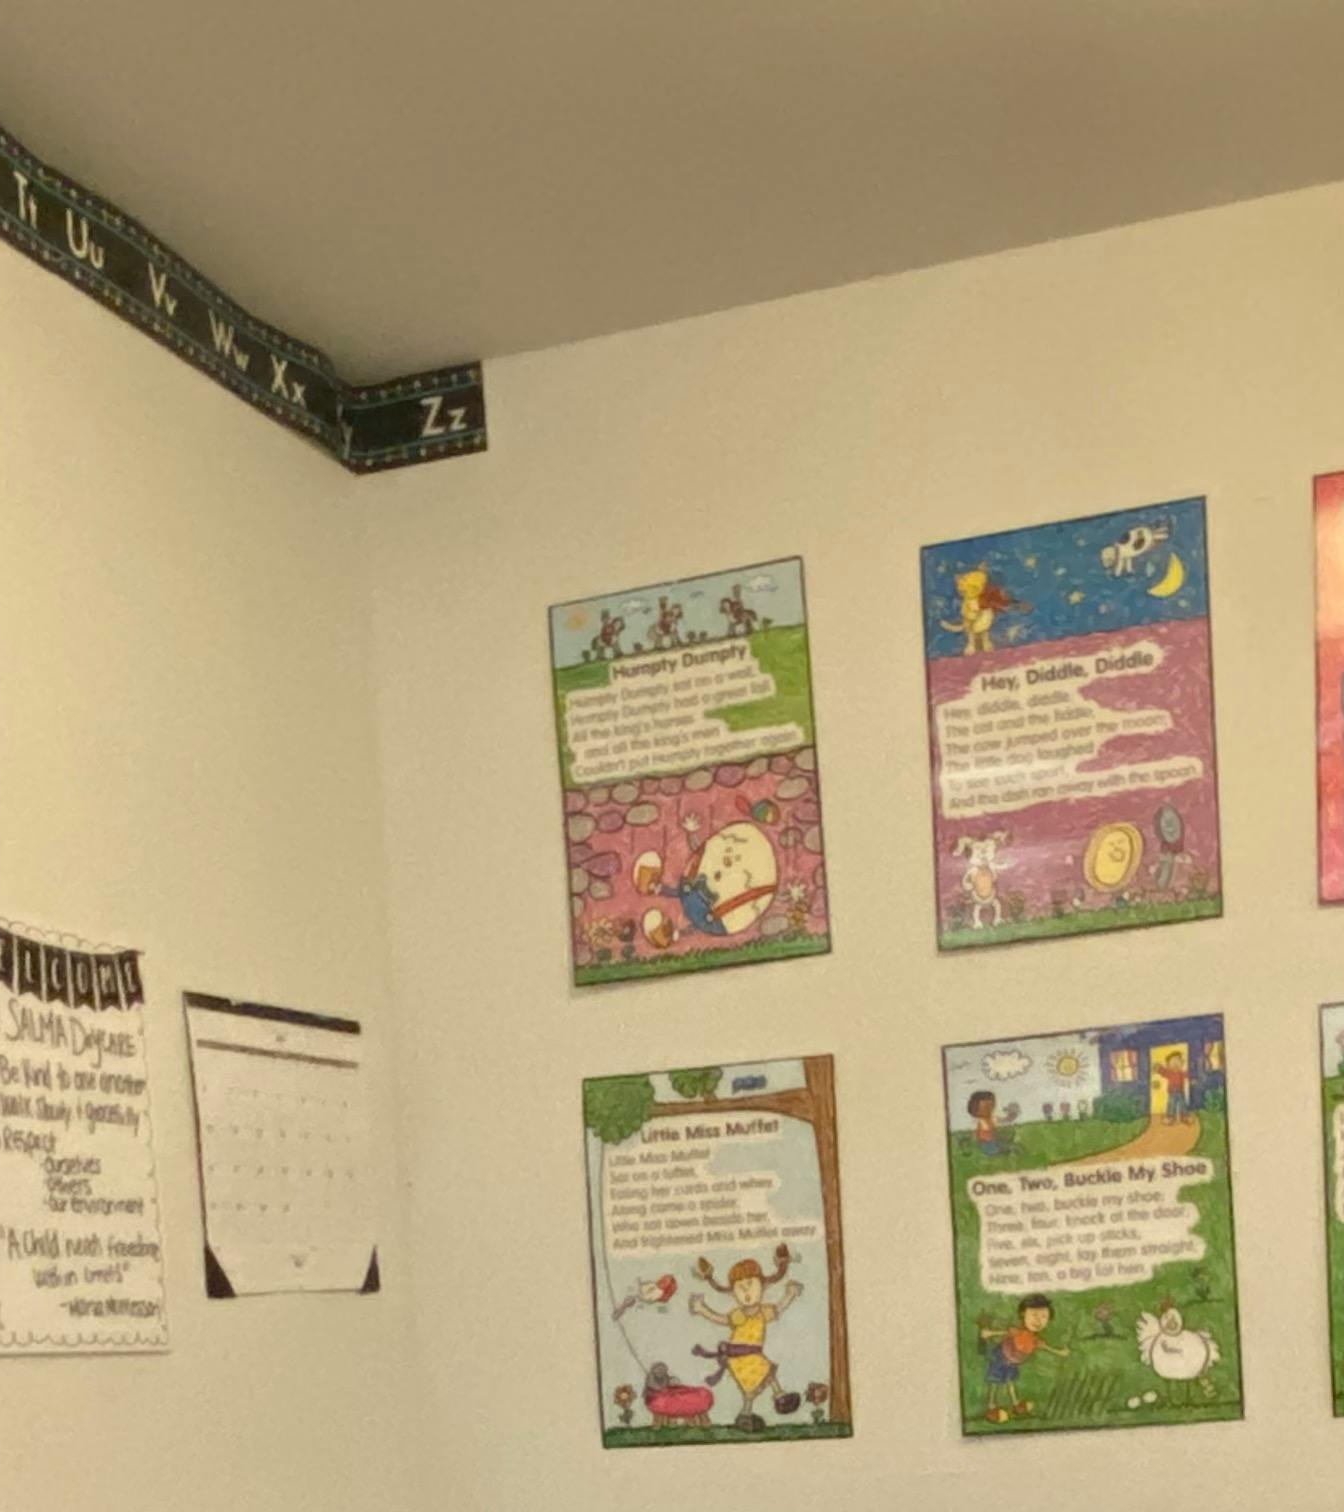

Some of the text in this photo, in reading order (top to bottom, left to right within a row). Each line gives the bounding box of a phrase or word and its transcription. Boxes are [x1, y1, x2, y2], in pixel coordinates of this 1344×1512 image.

[13, 171, 38, 229] Tt
[66, 208, 104, 269] Uu
[148, 262, 178, 316] Vv
[208, 309, 250, 371] Ww
[271, 355, 307, 407] Xx
[419, 396, 467, 436] Zz
[612, 641, 746, 684] Humpty Dumpty
[981, 649, 1154, 693] Hey, Diddle, Diddle
[640, 1118, 779, 1144] Little Miss Muffet
[972, 1159, 1207, 1197] One, Two, Buckle My Shoe
